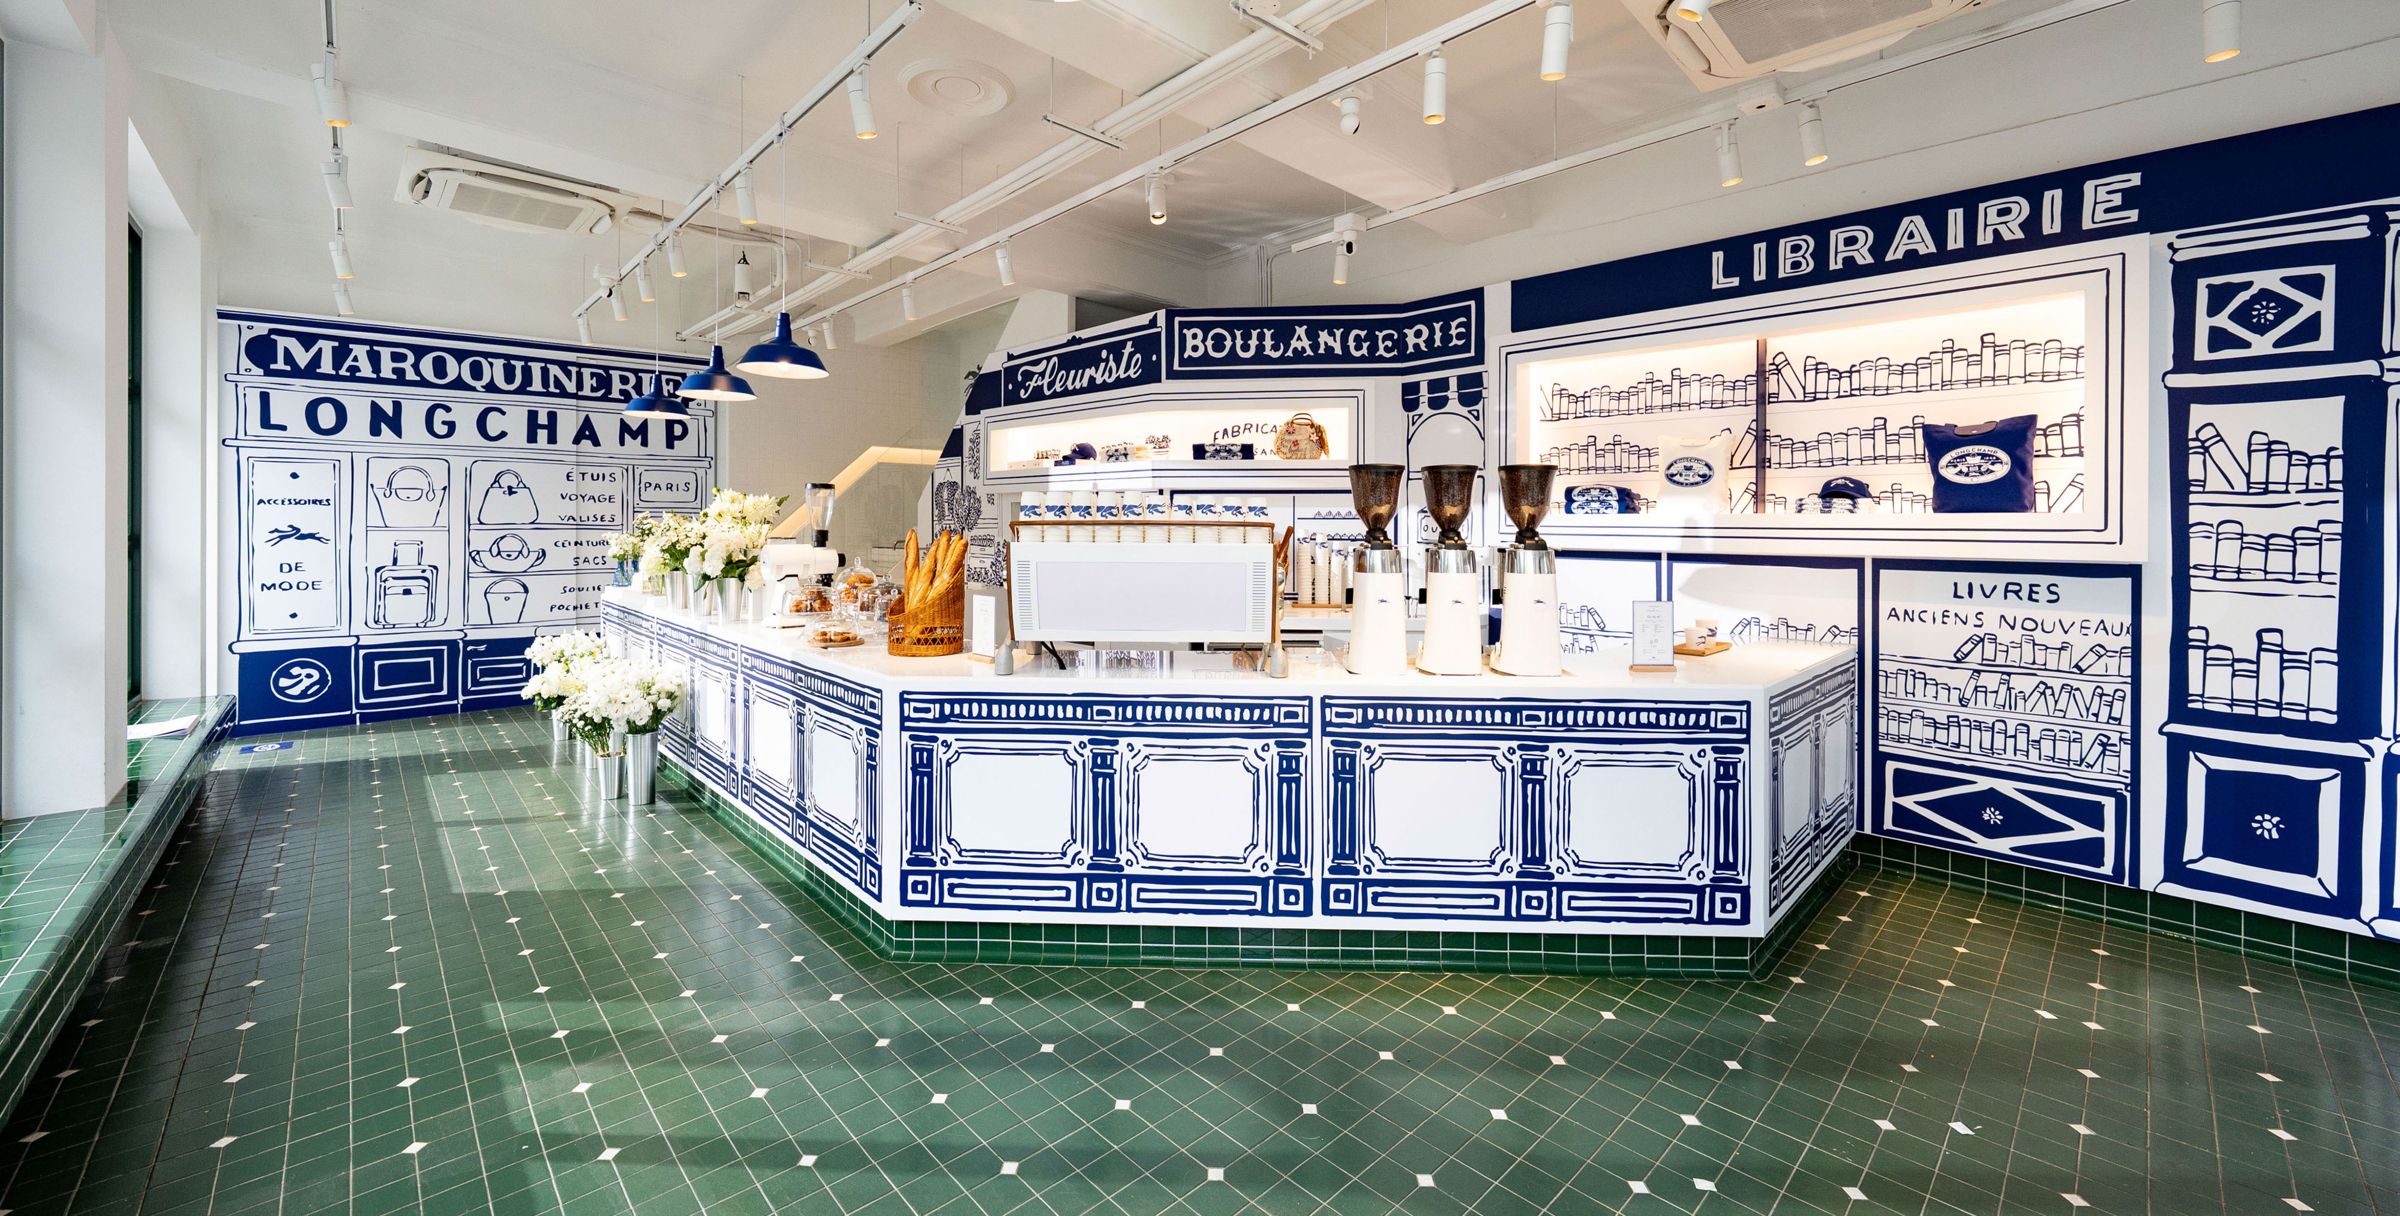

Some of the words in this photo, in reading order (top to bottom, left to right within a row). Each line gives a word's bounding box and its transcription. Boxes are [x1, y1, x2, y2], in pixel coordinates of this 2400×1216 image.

[1712, 172, 2142, 290] LIBRAIRIE
[1183, 317, 1469, 360] BOULANGERIE
[270, 334, 684, 400] MAROQUINERIE
[1017, 340, 1142, 399] Fleuriste
[259, 391, 689, 450] LONGCHAMP
[1213, 423, 1282, 444] FABRICA
[566, 467, 617, 482] ÉTUIS
[644, 481, 691, 492] PARIS
[560, 492, 616, 504] VOYAGE
[558, 514, 616, 523] VALISES
[554, 539, 611, 548] CEINTURE
[279, 562, 306, 574] DE
[573, 556, 607, 567] SACS
[261, 580, 324, 592] MODE
[560, 584, 603, 595] SOULIE
[1953, 581, 2061, 604] LIVRES
[550, 601, 600, 613] POCHET
[1887, 607, 1984, 628] ANCIENS
